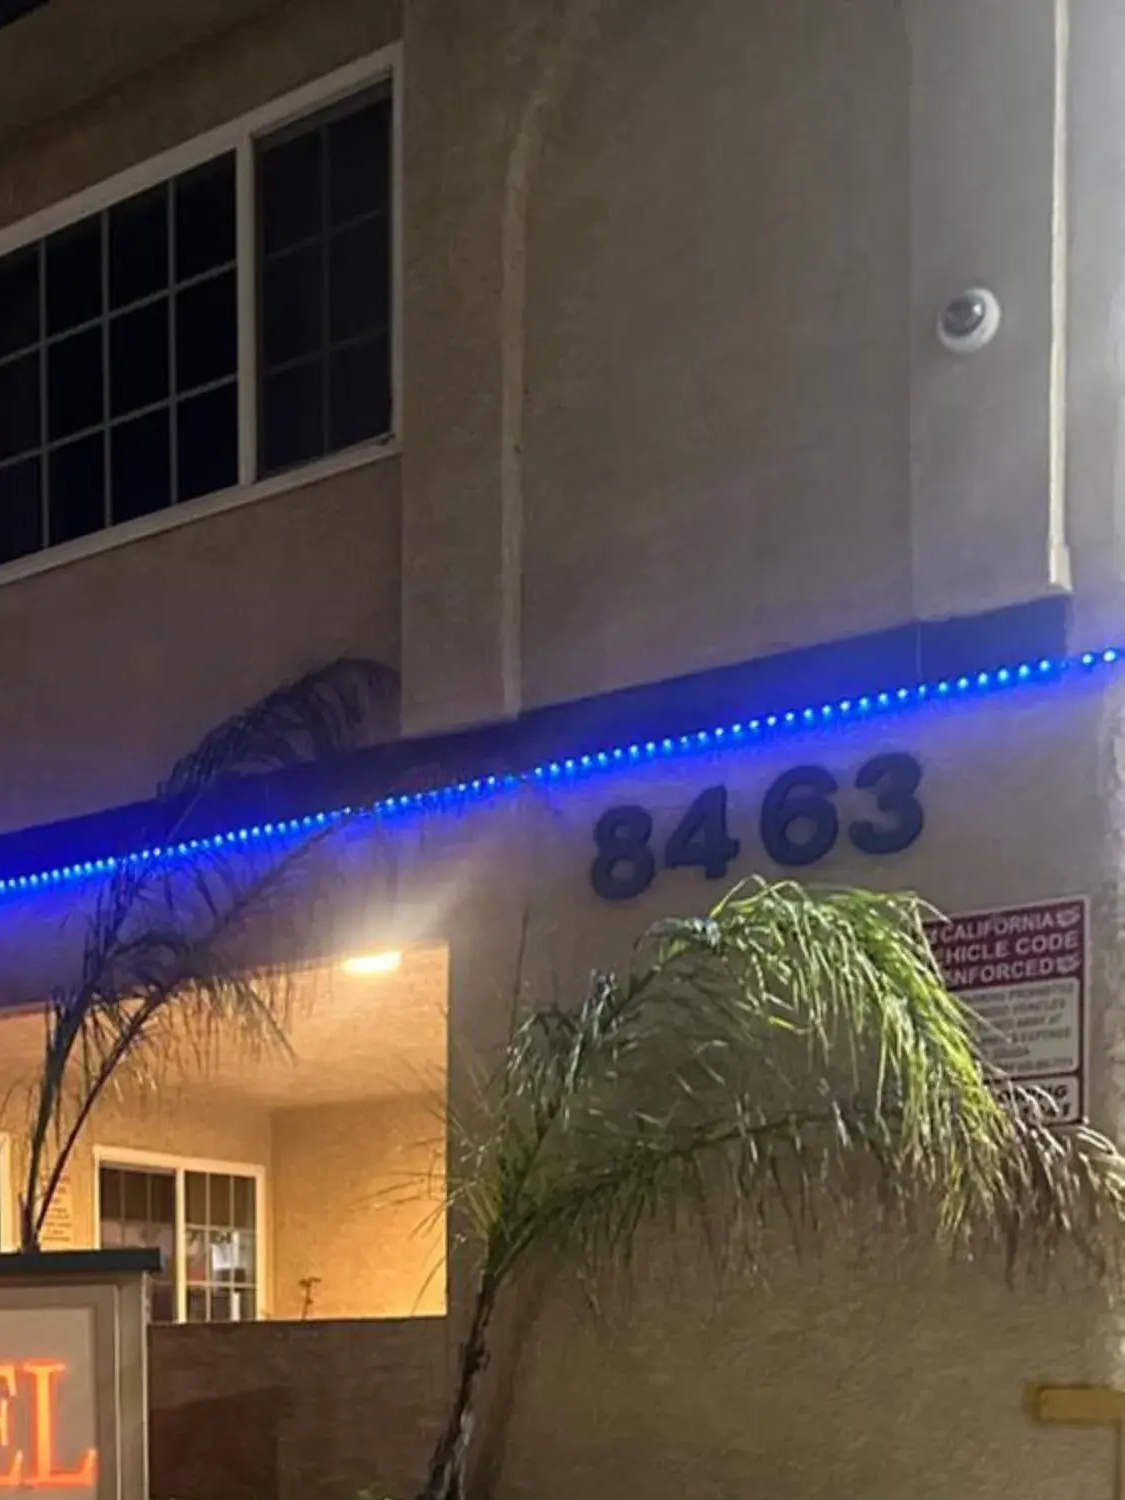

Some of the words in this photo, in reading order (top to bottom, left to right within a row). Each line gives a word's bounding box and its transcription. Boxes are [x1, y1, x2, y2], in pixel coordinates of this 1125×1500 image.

[589, 752, 924, 900] 8463
[940, 911, 1055, 943] CALIFORNIA
[932, 939, 1010, 967] HICLE
[1015, 930, 1079, 955] CODE
